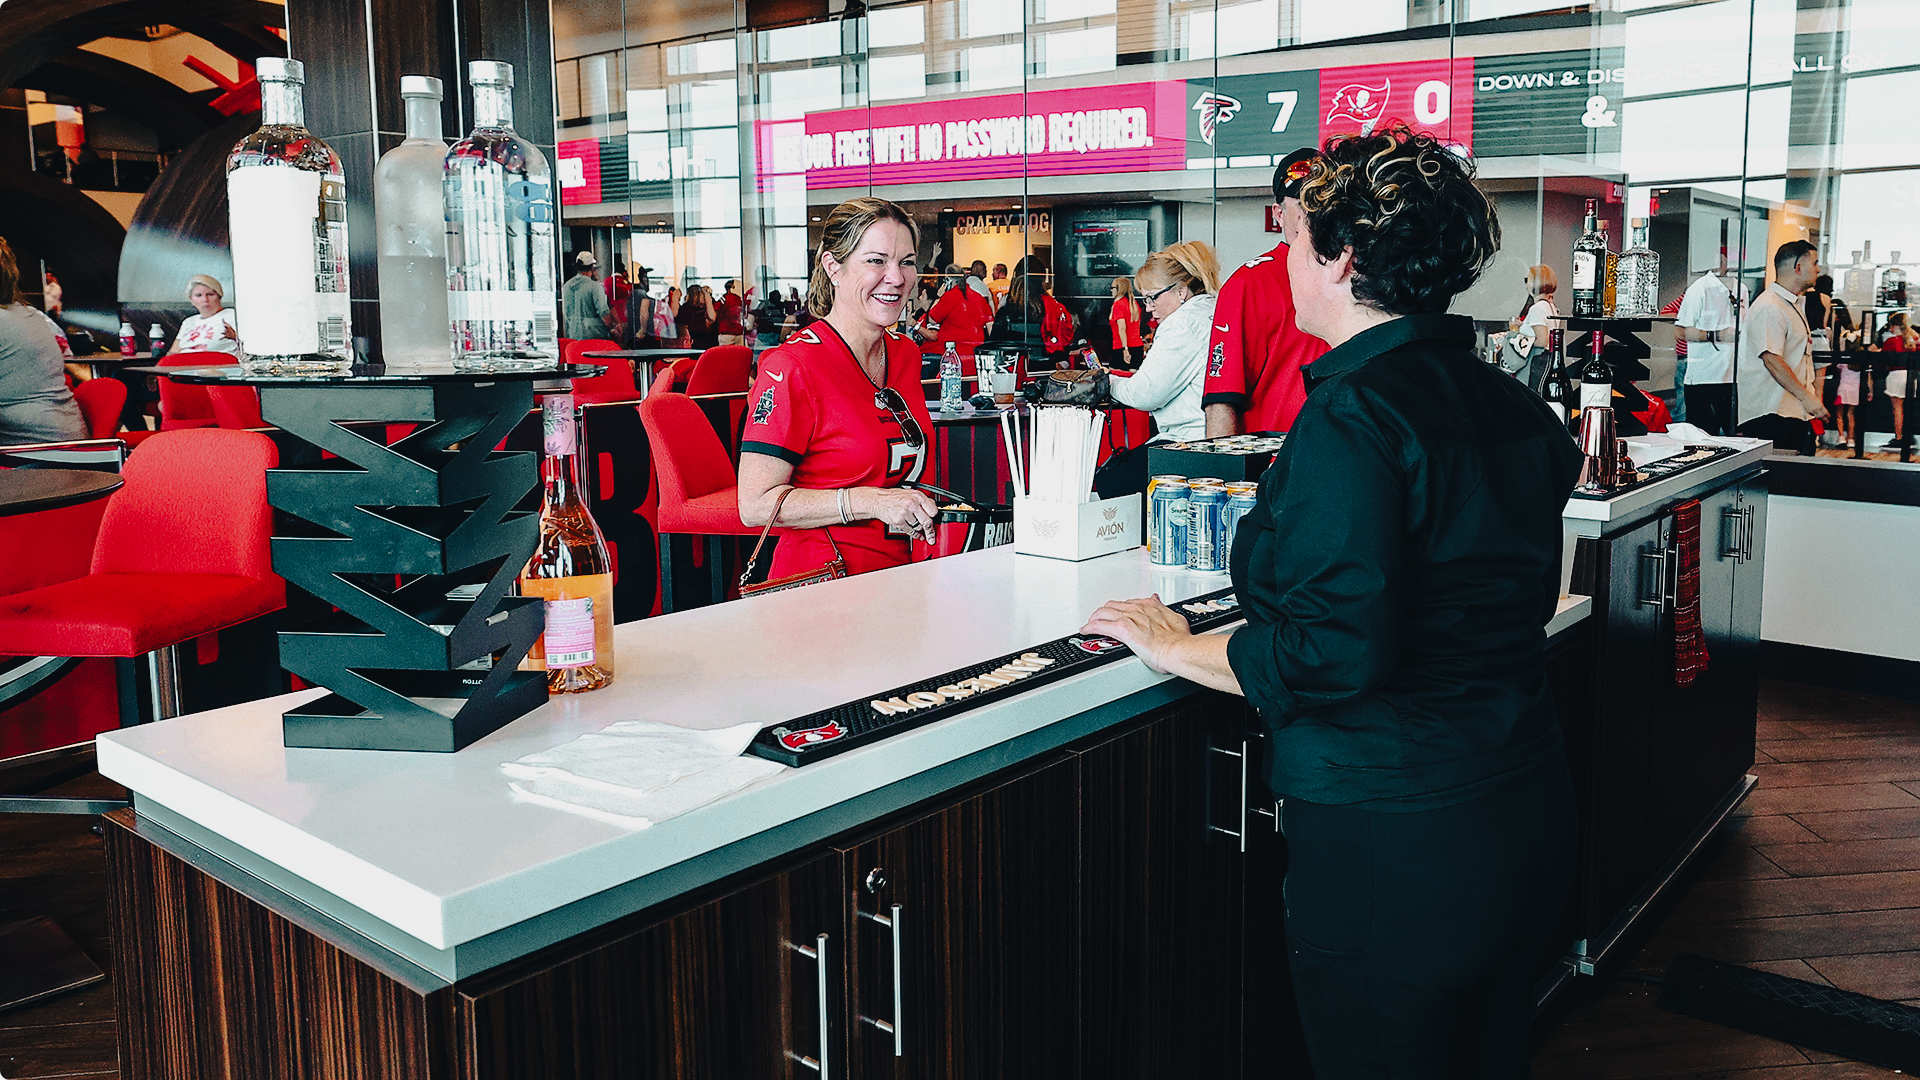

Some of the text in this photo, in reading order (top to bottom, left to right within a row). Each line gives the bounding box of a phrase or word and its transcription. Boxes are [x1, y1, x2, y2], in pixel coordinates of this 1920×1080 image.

[1478, 61, 1723, 93] DOWN & DISTANCE
[1759, 52, 1887, 76] BALL ON
[1266, 90, 1298, 133] 7
[1413, 80, 1450, 125] 0
[1580, 95, 1617, 128] &
[802, 131, 834, 170] OUR
[835, 129, 869, 168] FREE
[872, 124, 917, 165] WIFI!
[918, 121, 943, 162] NO
[945, 113, 1046, 161] PASSWORD
[1049, 106, 1154, 155] REQUIRED.
[956, 213, 1013, 235] CRAFTY
[1096, 521, 1125, 538] AVIÓN
